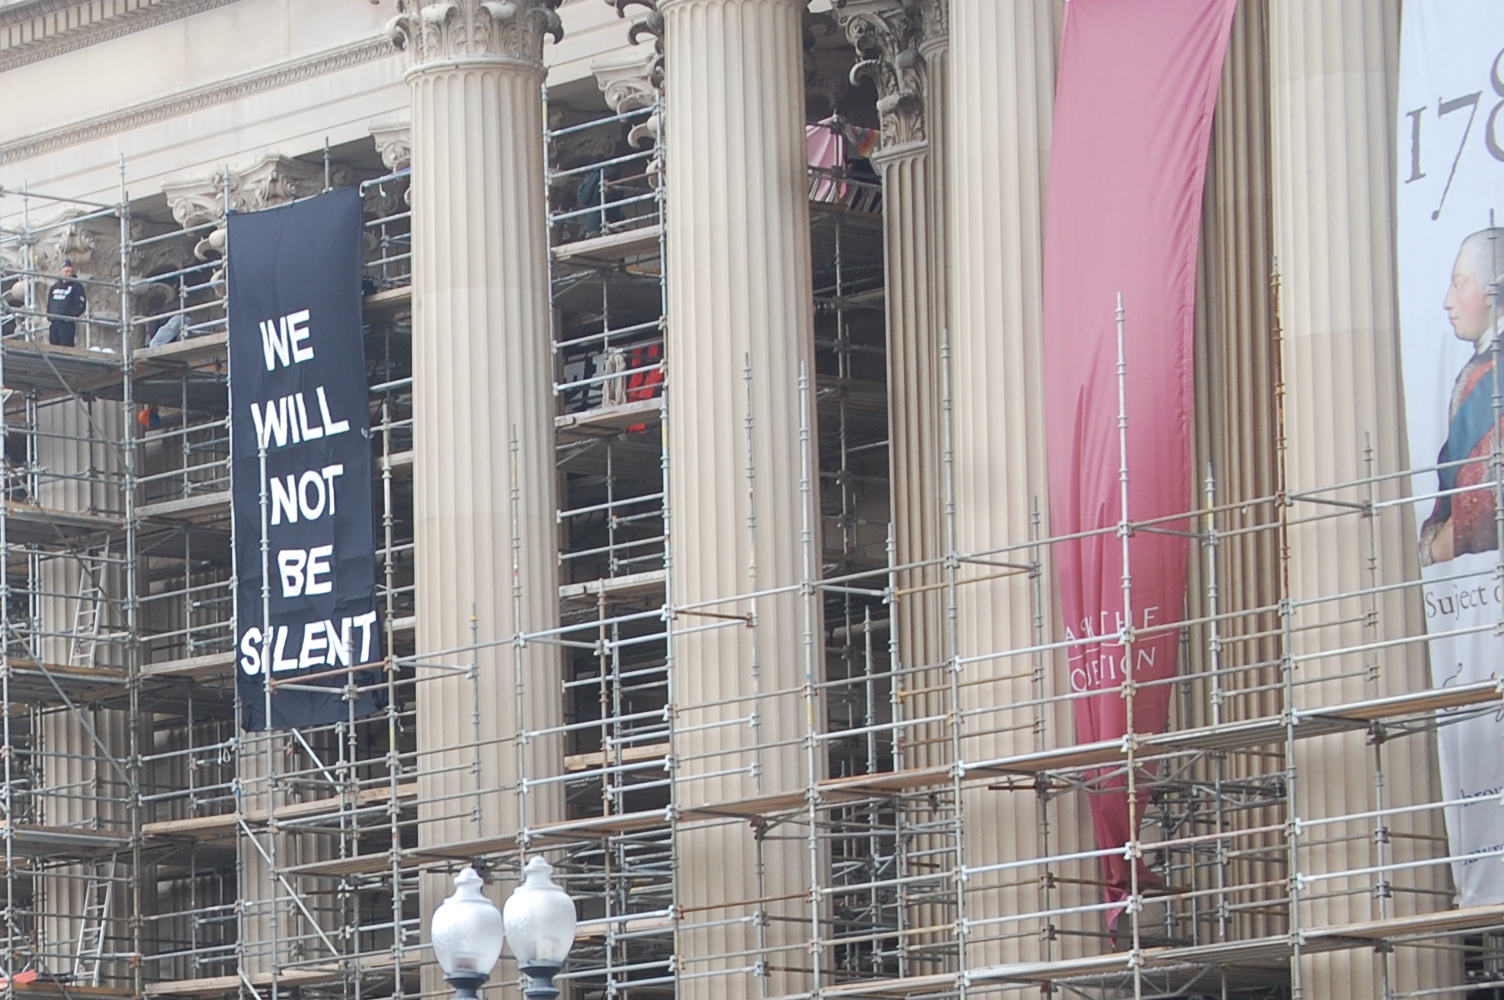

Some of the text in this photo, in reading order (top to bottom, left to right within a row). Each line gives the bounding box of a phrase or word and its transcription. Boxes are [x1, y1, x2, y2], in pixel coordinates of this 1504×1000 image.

[259, 309, 314, 371] WE
[250, 386, 350, 447] WILL
[270, 464, 344, 525] NOT
[278, 545, 333, 597] BE
[1426, 584, 1488, 620] Suject
[241, 610, 377, 676] SILENT
